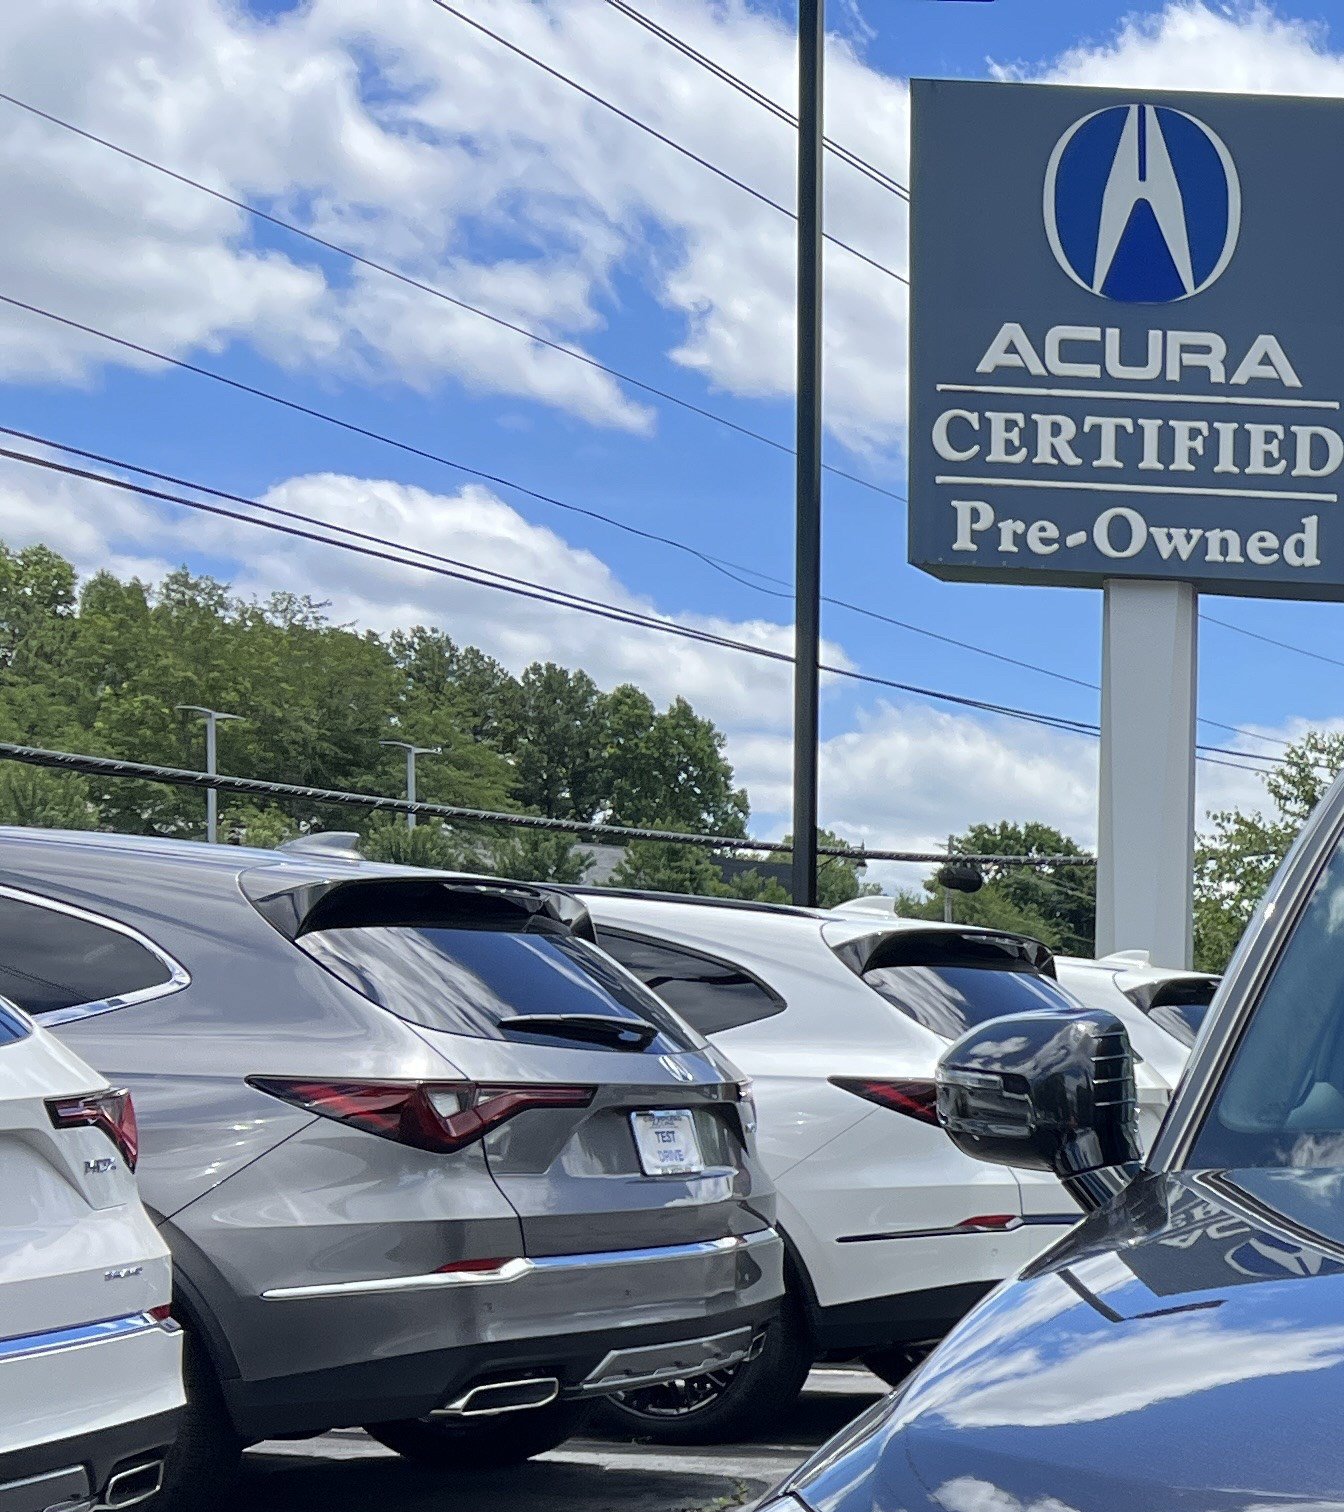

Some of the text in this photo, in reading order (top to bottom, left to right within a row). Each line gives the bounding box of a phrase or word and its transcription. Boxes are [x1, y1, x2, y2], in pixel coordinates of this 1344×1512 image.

[975, 322, 1302, 388] ACURA
[931, 408, 1344, 478] CERTIFIED
[951, 500, 1320, 568] Pre-Owned
[654, 1130, 676, 1143] TEST
